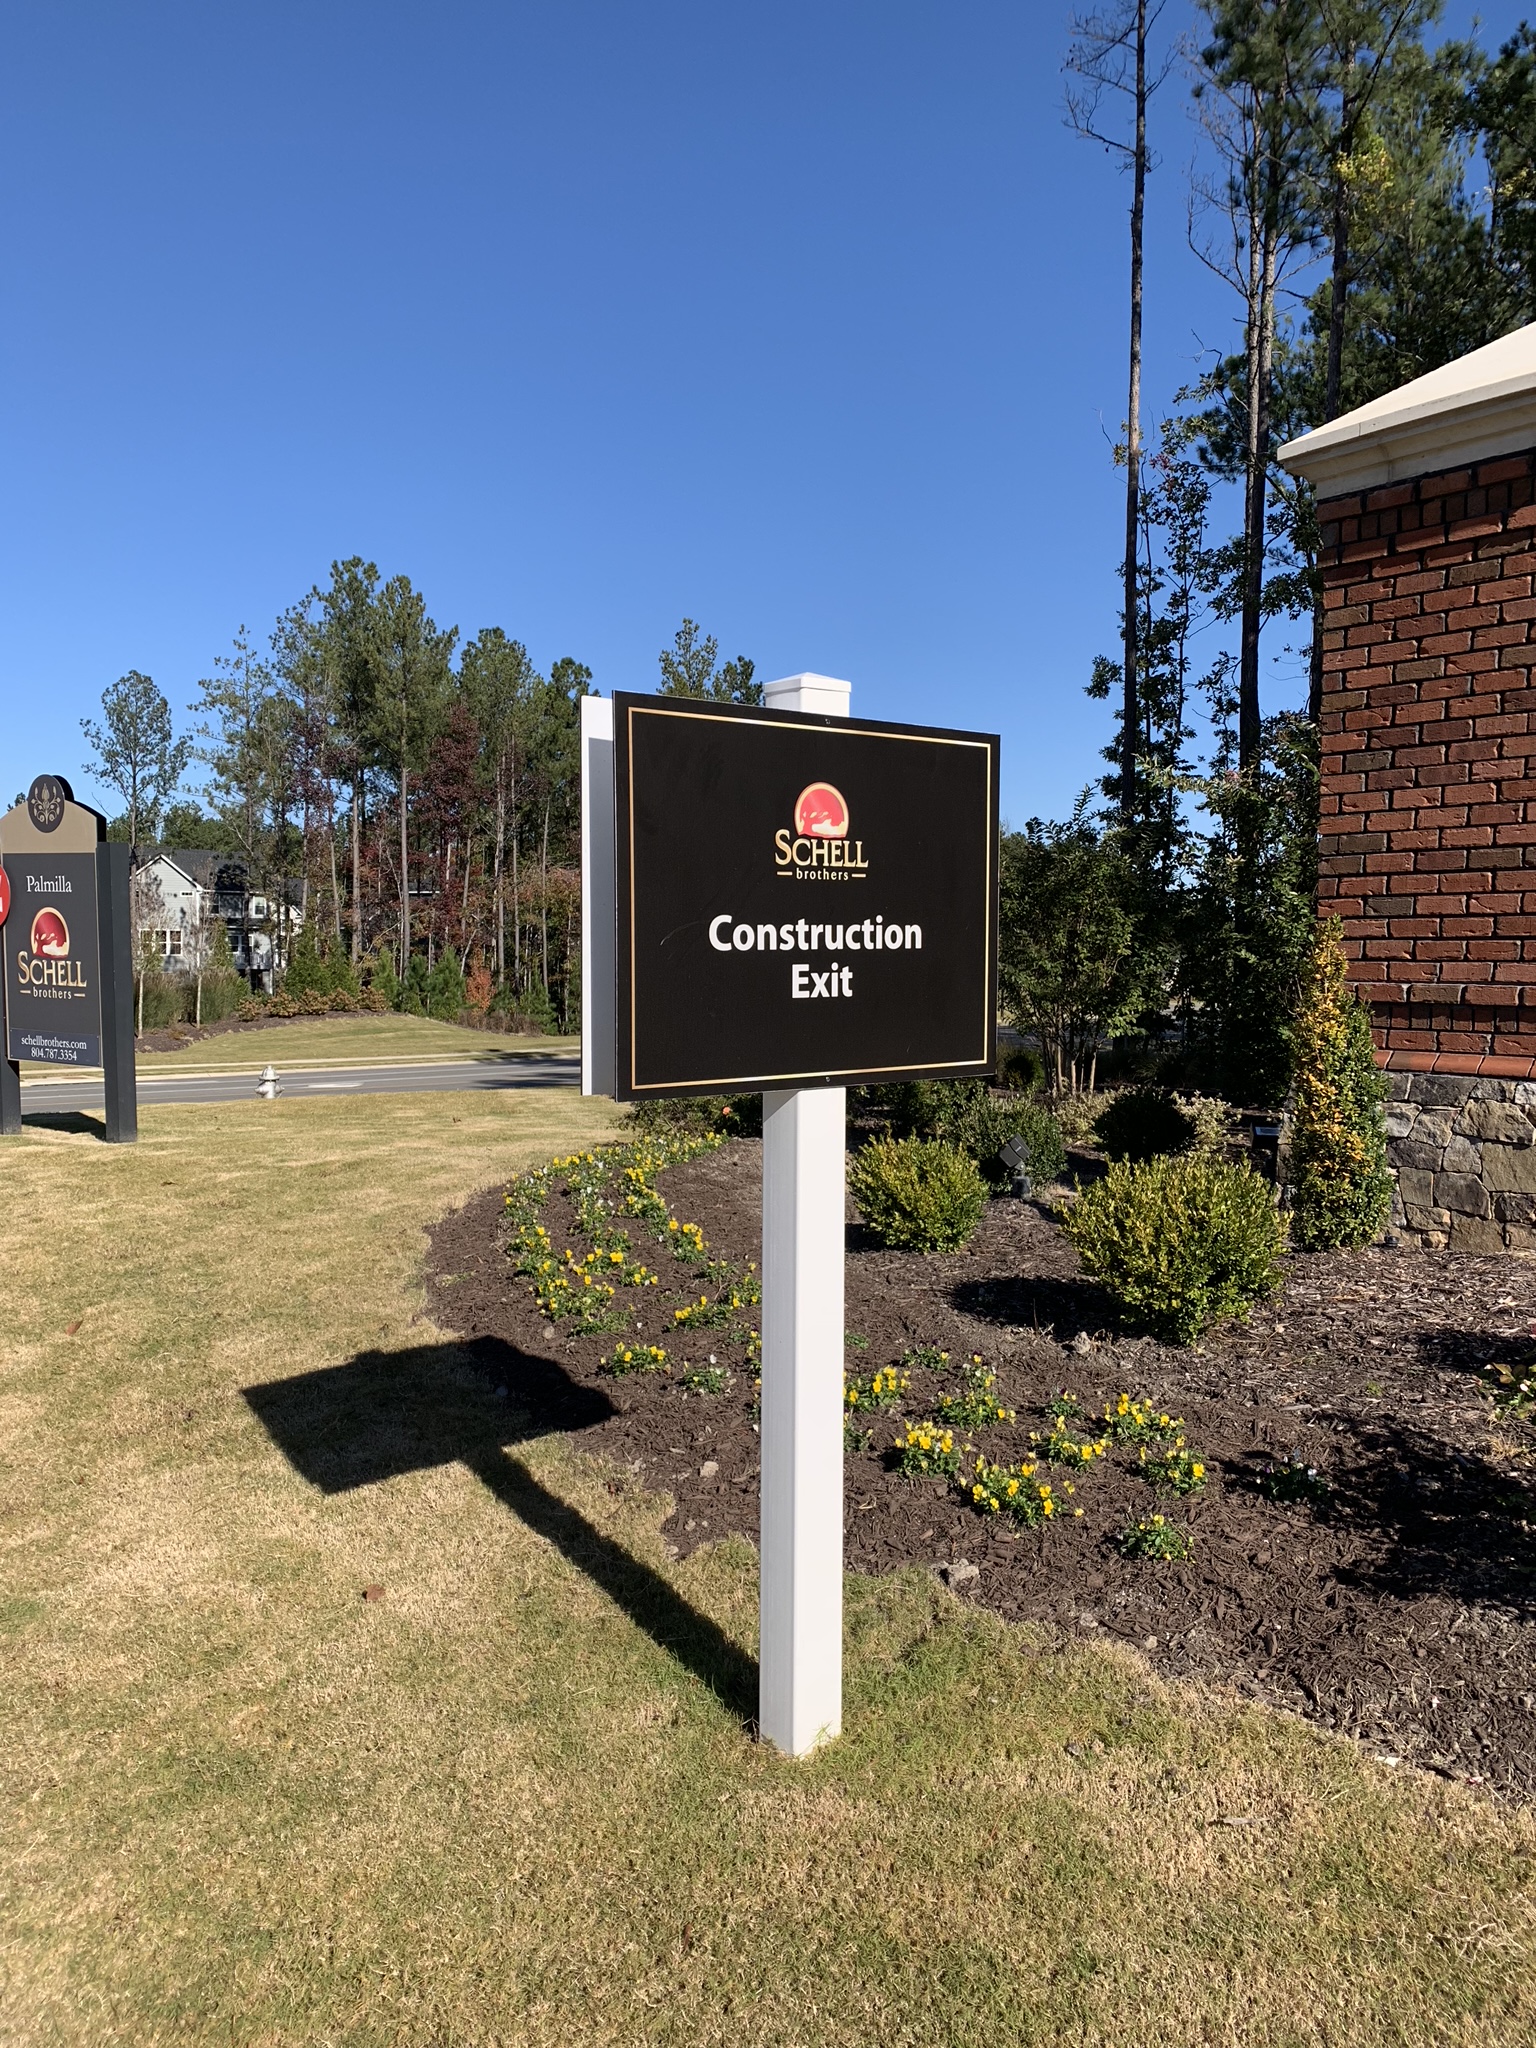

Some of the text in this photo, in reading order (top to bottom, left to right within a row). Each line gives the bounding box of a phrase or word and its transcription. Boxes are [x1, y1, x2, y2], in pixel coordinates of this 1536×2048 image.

[775, 829, 868, 868] SCHELL
[796, 868, 848, 880] brothers
[26, 875, 72, 892] Palmilla
[708, 914, 922, 951] Construction
[17, 950, 87, 987] SCHELL
[791, 962, 853, 999] Exit
[33, 987, 72, 999] brothers
[21, 1034, 87, 1050] schellbrothers.com
[30, 1047, 77, 1061] 804.787.3354
